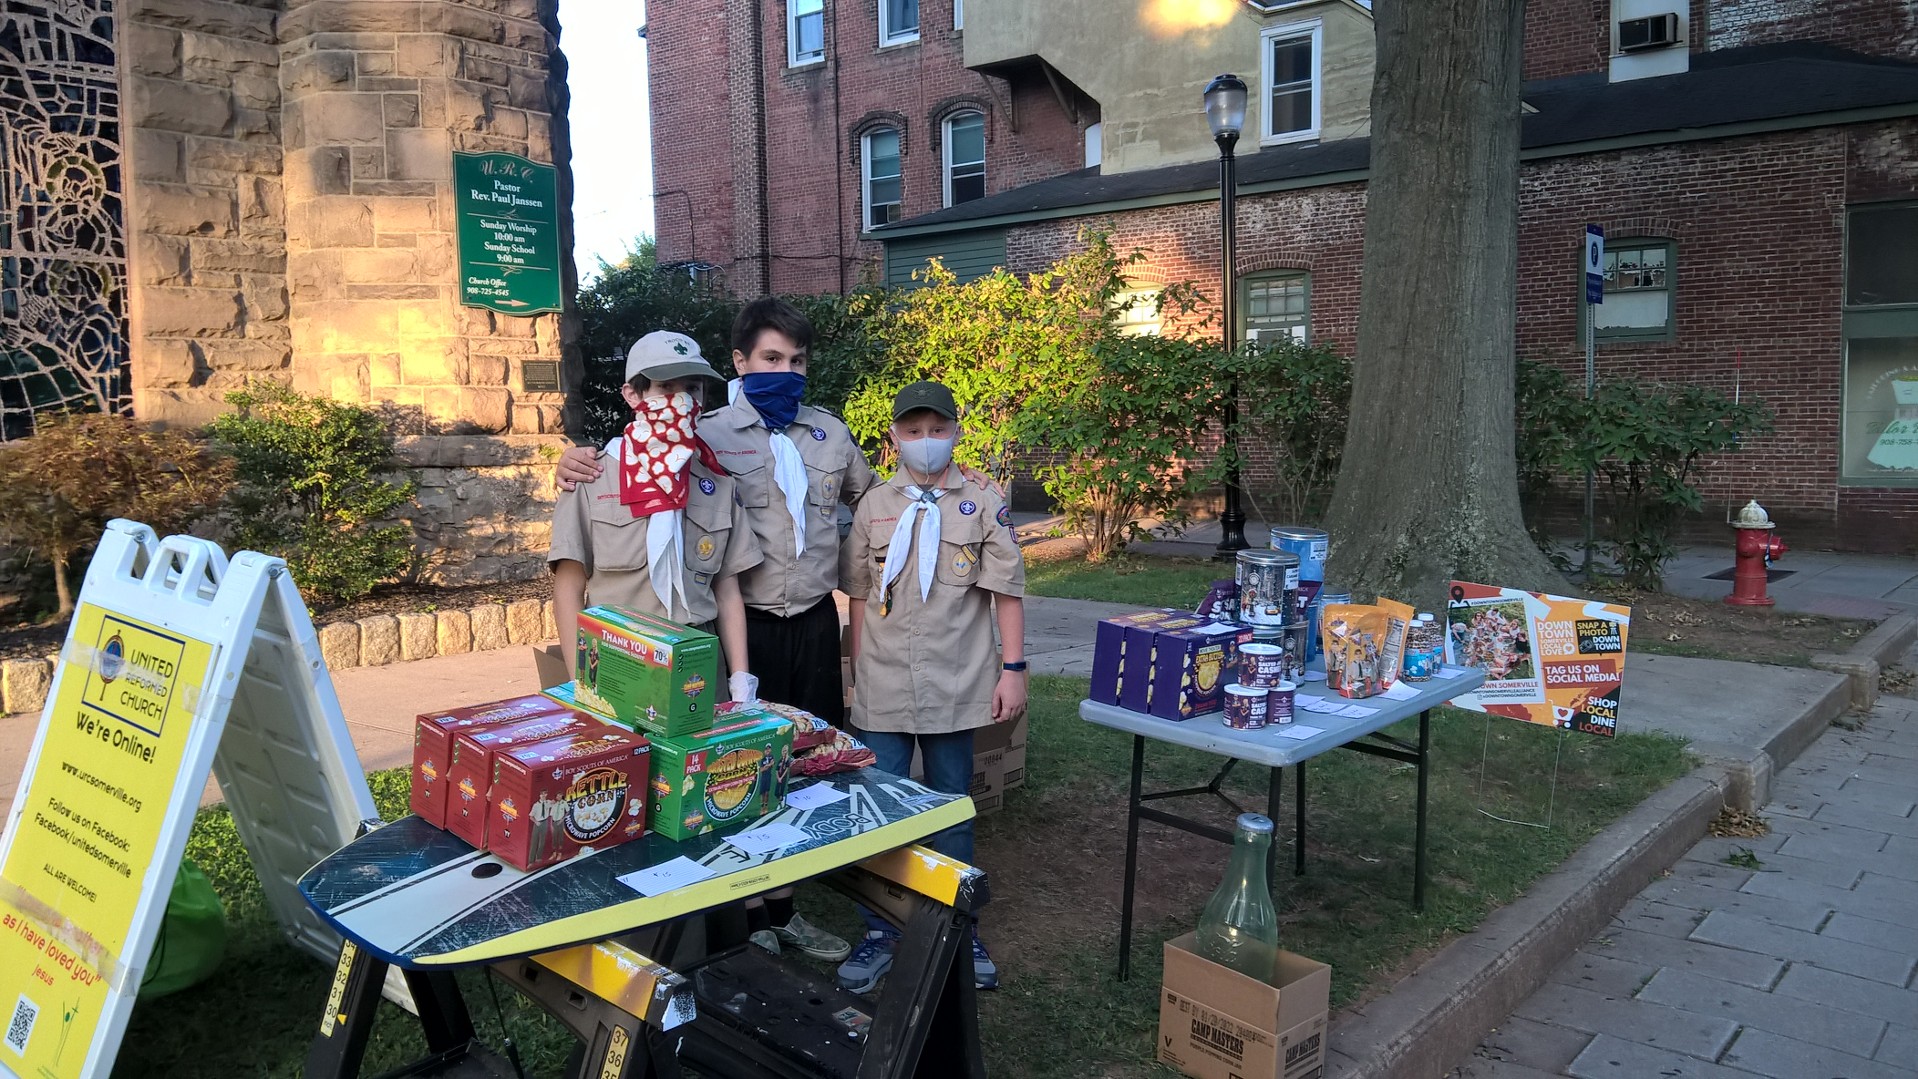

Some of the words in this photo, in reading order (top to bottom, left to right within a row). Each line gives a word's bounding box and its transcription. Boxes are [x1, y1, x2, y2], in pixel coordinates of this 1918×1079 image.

[494, 180, 521, 193] Pastor
[471, 189, 490, 201] Rev.
[492, 191, 511, 204] Paul
[511, 195, 543, 208] Janssen
[480, 219, 507, 231] Sunday
[508, 222, 537, 235] Worship
[494, 232, 513, 242] 10:00
[514, 235, 525, 243] am
[484, 242, 510, 254] Sunday
[511, 245, 535, 255] School
[497, 254, 513, 264] 9:00
[468, 277, 490, 286] Church
[1537, 621, 1573, 631] DOWN
[1539, 629, 1573, 639] TOWN
[1580, 629, 1608, 637] PHOTO
[602, 629, 629, 648] THANK
[630, 640, 648, 655] YOU
[130, 649, 173, 678] UNITED
[654, 650, 668, 664] 70%
[1545, 666, 1566, 675] TAG
[1568, 665, 1582, 674] US
[1583, 664, 1600, 673] ON
[125, 673, 168, 698] REFORMED
[1547, 675, 1584, 684] SOCIAL
[1585, 673, 1620, 682] MEDIA!
[120, 691, 163, 721] CHURCH
[1587, 696, 1617, 709] SHOP
[1581, 704, 1616, 719] LOCAL
[1590, 714, 1616, 728] DINE
[76, 711, 110, 743] We're
[113, 730, 156, 764] Online!
[1579, 722, 1613, 737] LOCAL
[639, 746, 650, 754] PACK
[576, 762, 597, 773] SCOUTS
[604, 754, 629, 765] AMERICA
[691, 754, 699, 764] 14
[686, 765, 701, 774] PACK
[61, 761, 142, 813] www.urcsomerville.org
[565, 771, 628, 802] KETTLE
[577, 790, 614, 809] CORN
[729, 792, 752, 816] POPCORN
[48, 797, 72, 818] Follow
[71, 814, 80, 824] us
[82, 817, 91, 827] on
[91, 821, 130, 852] Facebook:
[564, 814, 589, 839] MICROWAVE
[588, 817, 616, 838] POPCORN
[34, 812, 132, 879] Facebook/unitedsomerville
[43, 863, 54, 876] ALL
[55, 869, 67, 884] ARE
[3, 913, 17, 929] as
[16, 920, 24, 932] I
[20, 922, 46, 950] have
[45, 939, 76, 971] loved
[341, 953, 352, 967] 33
[336, 970, 347, 985] 32
[331, 986, 342, 1002] 31
[326, 1003, 337, 1018] 30
[613, 1030, 628, 1047] 37
[1191, 1018, 1211, 1039] CAMP
[1210, 1025, 1244, 1055] MASTERS
[608, 1050, 622, 1067] 36
[1286, 1043, 1299, 1064] CAMP
